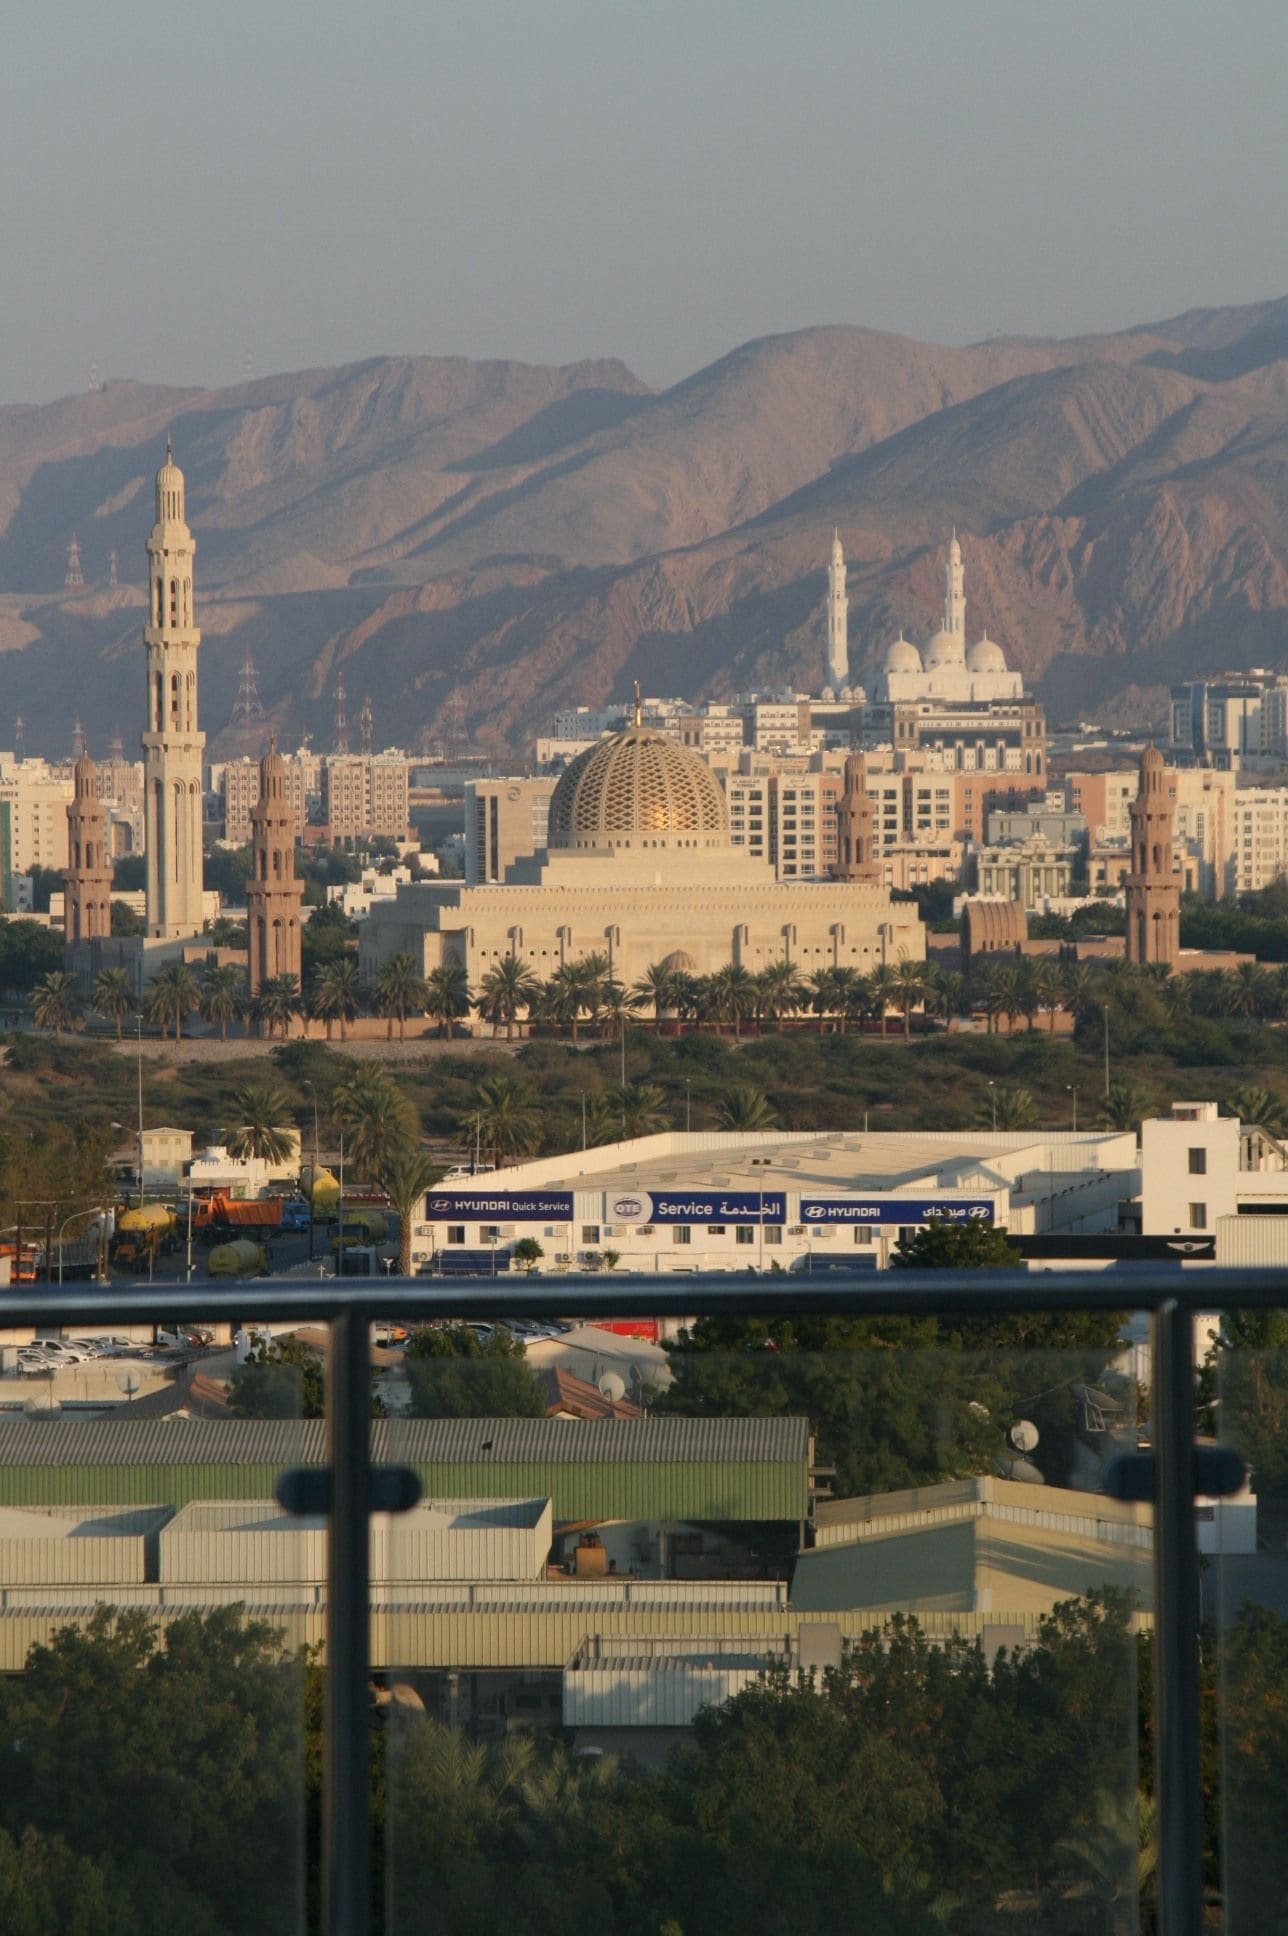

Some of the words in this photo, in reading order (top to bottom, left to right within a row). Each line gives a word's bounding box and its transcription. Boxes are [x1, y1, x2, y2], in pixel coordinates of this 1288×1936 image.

[455, 1200, 510, 1211] HYUNDAI
[512, 1201, 537, 1211] Quick
[538, 1201, 570, 1211] Service
[658, 1201, 713, 1215] Service
[719, 1201, 780, 1215] الخدمة
[828, 1207, 881, 1217] HYUNDAI
